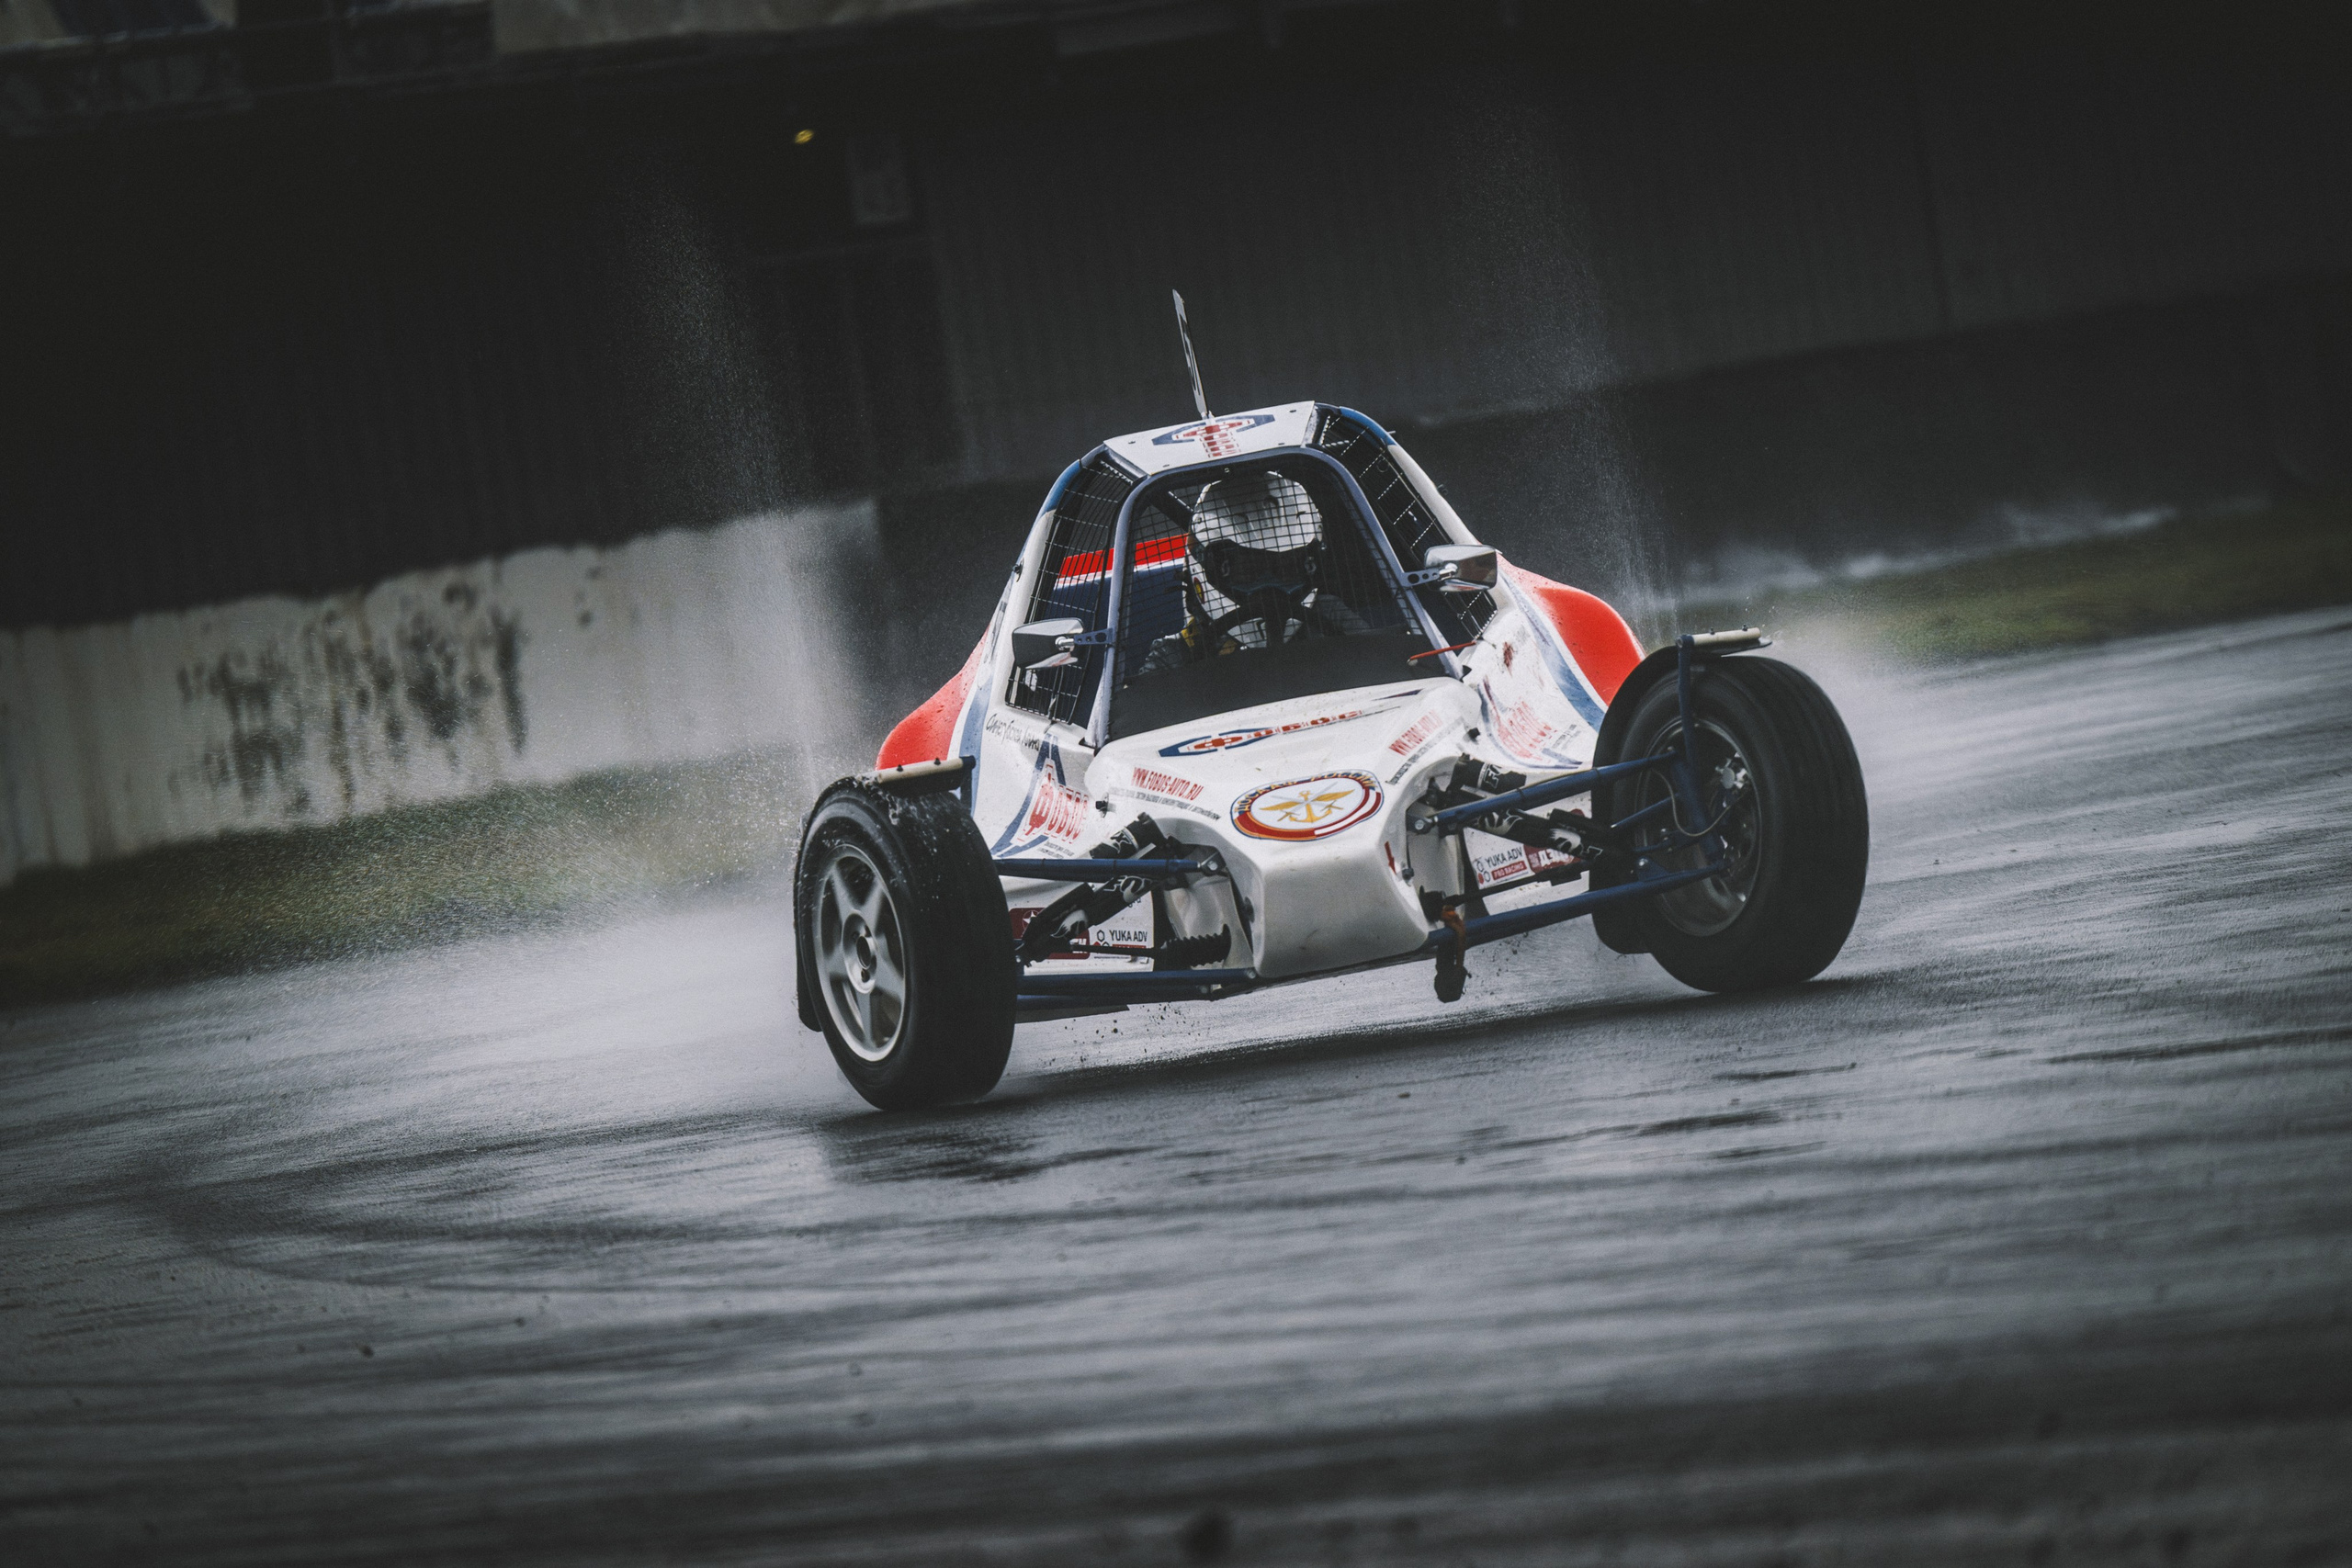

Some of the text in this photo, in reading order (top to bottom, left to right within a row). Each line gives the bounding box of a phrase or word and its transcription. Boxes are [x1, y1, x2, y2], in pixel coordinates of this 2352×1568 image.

[1485, 853, 1507, 868] YUKA
[1507, 846, 1523, 862] ADV
[1109, 930, 1148, 942] YUKA ADV
